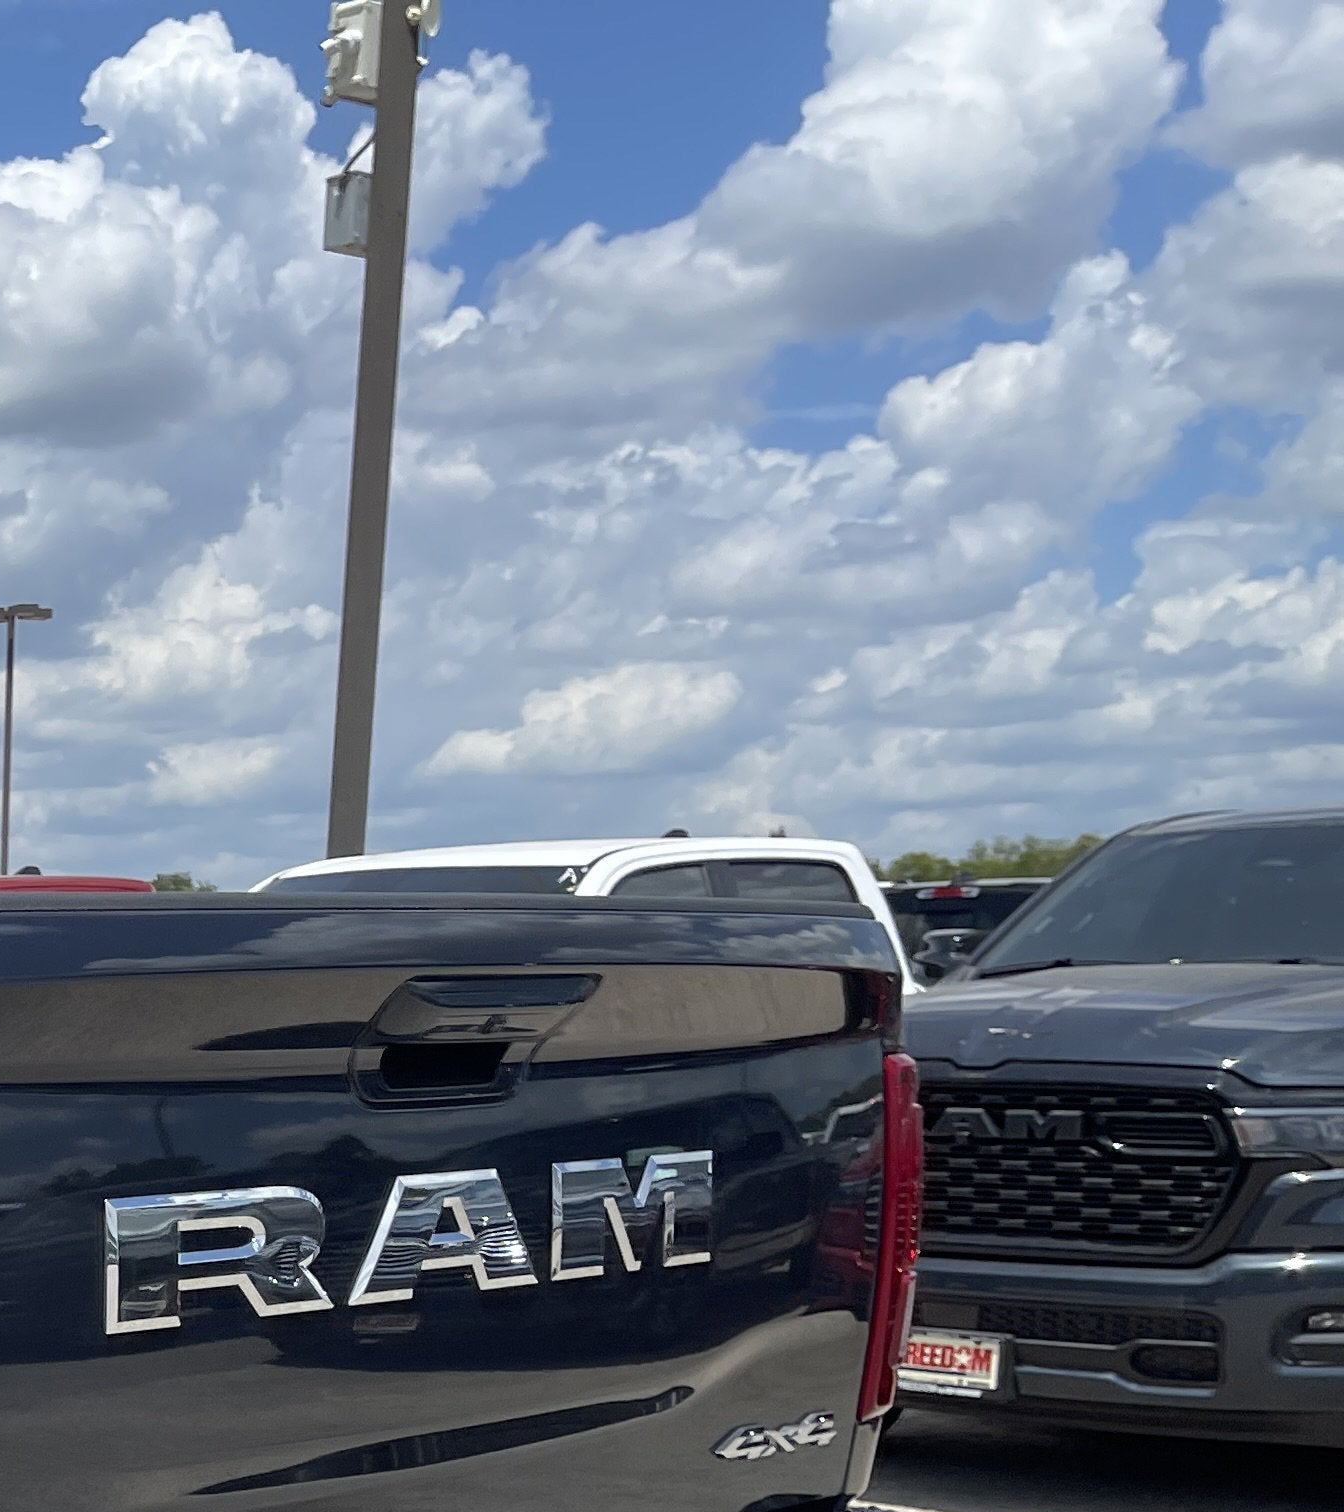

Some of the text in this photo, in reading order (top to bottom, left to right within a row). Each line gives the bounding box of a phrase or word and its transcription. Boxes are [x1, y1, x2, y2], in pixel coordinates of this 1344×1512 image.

[923, 1106, 1085, 1140] AM
[104, 1149, 714, 1335] RAM
[906, 1343, 993, 1373] REEDOM
